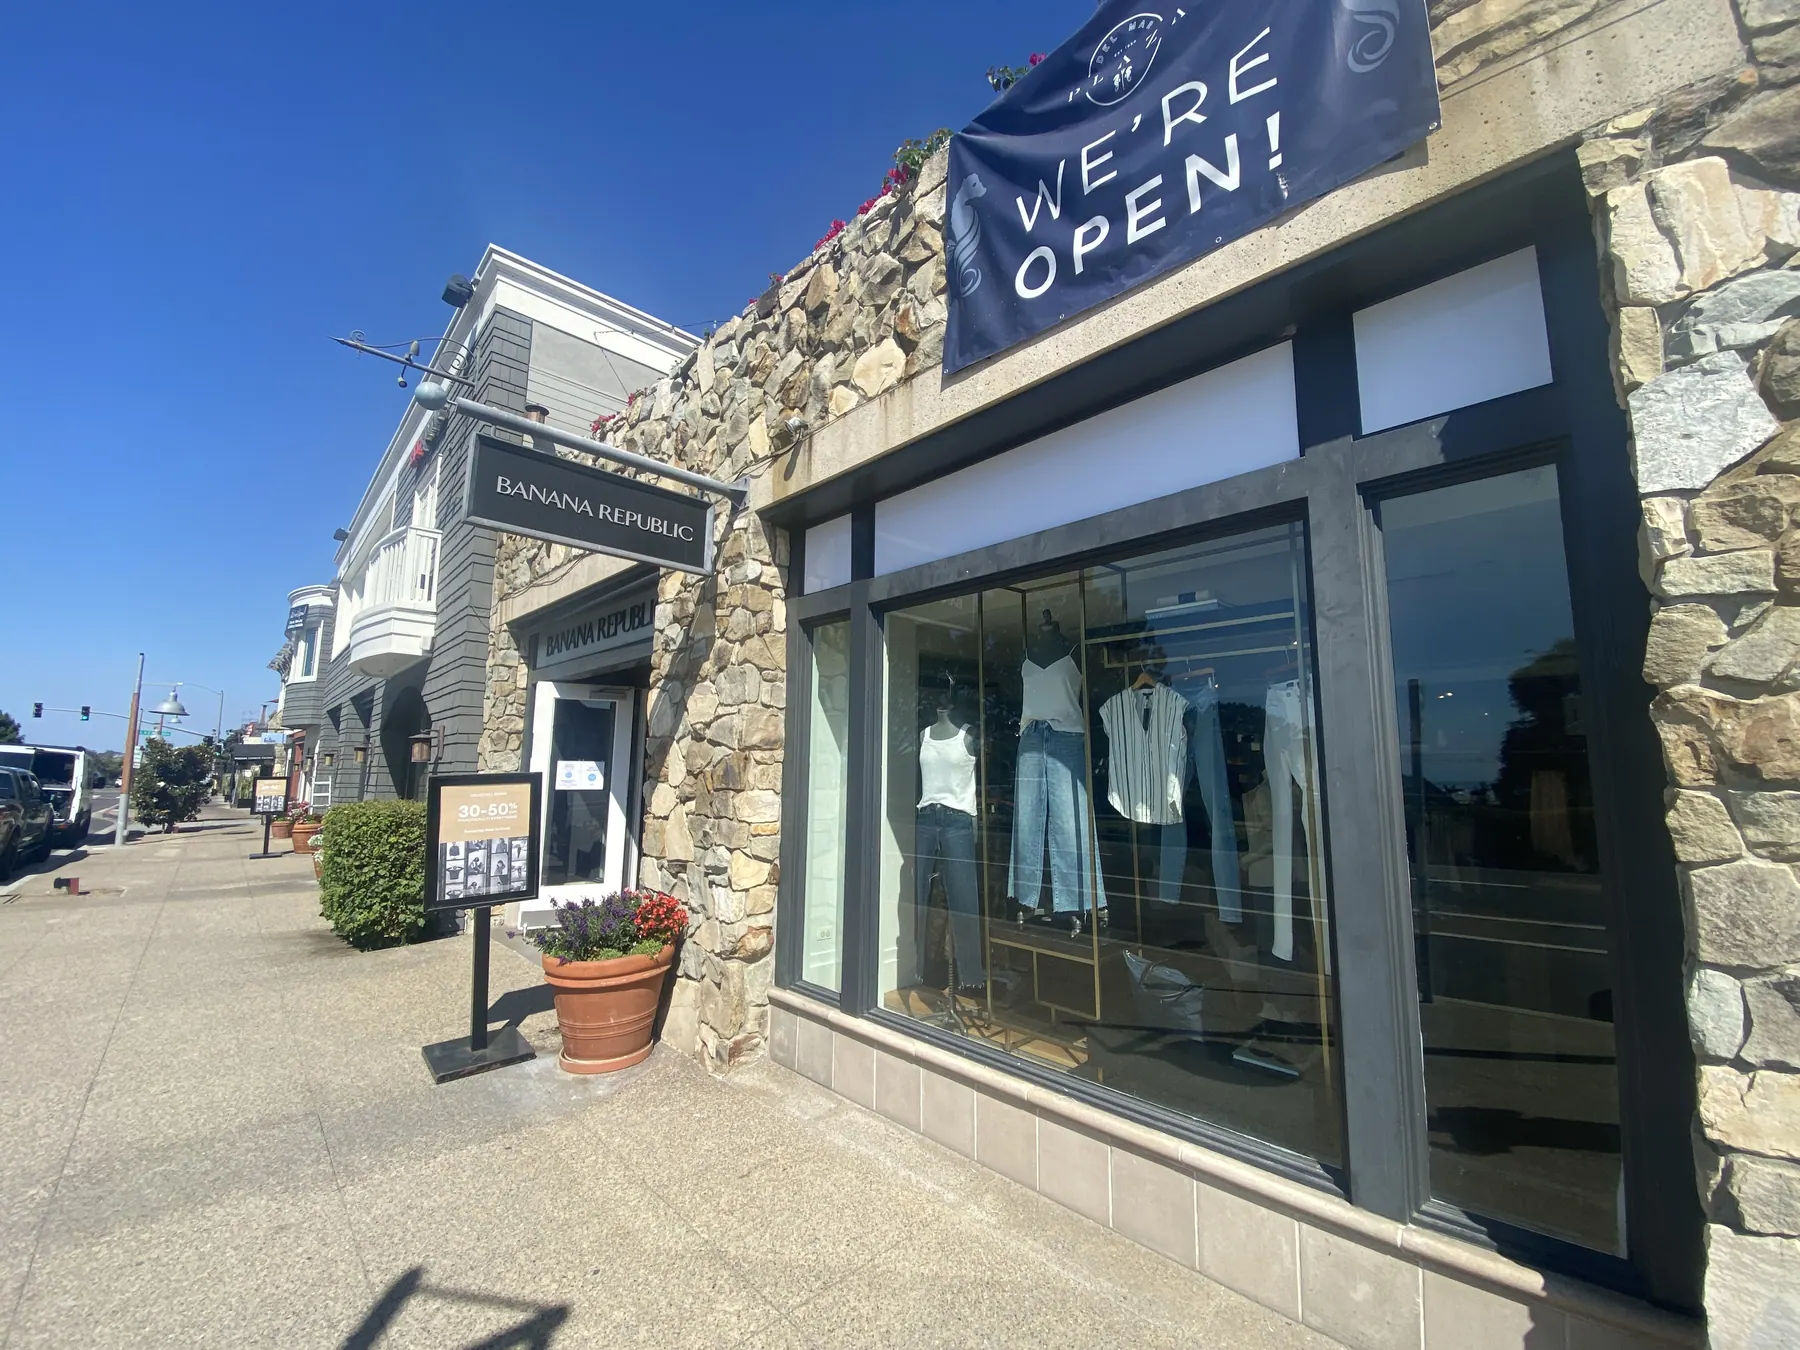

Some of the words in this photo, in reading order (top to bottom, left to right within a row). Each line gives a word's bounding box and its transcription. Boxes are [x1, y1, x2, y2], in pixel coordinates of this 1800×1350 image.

[1096, 36, 1118, 64] DEL
[1128, 19, 1154, 32] MAR
[1016, 27, 1278, 232] WE'RE
[1015, 111, 1282, 299] OPEN!
[496, 475, 594, 518] BANANA
[598, 503, 694, 541] REPUBLIC
[546, 621, 595, 657] BANANA
[597, 599, 655, 641] REPUBLI
